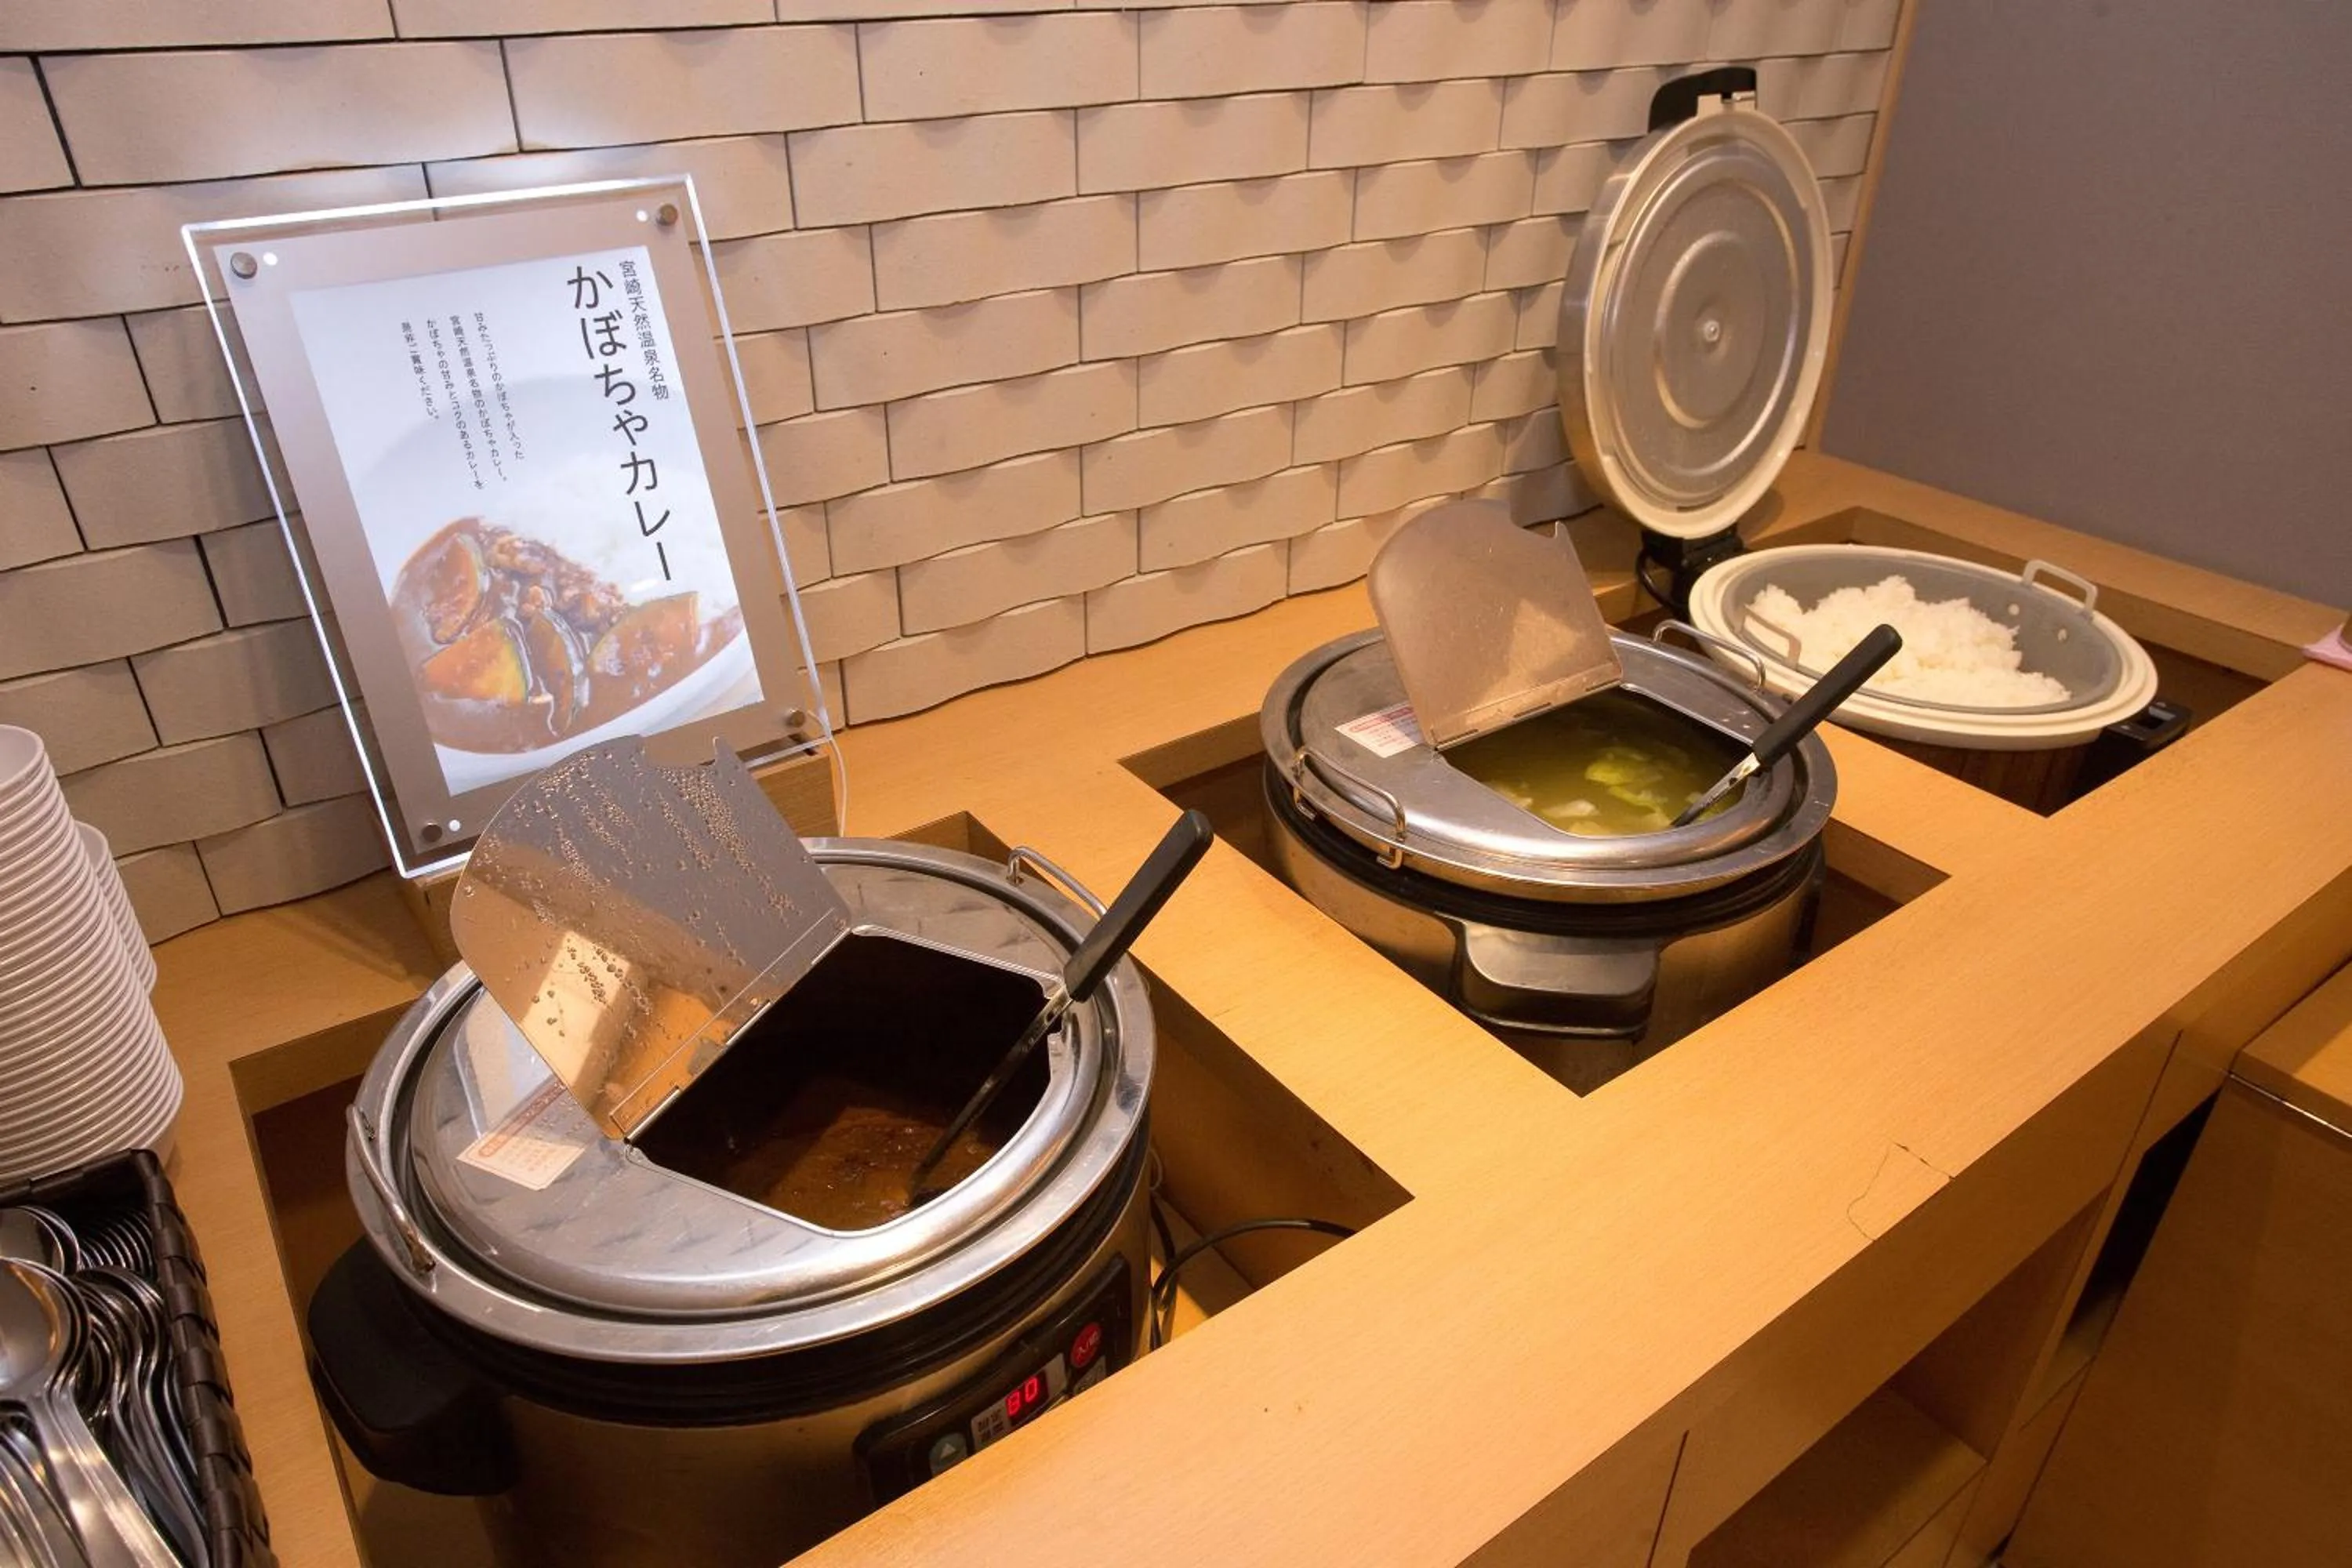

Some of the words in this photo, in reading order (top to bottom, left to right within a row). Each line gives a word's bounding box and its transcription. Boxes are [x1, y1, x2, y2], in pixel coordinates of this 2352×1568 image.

[567, 266, 672, 581] かぼちゃカレー
